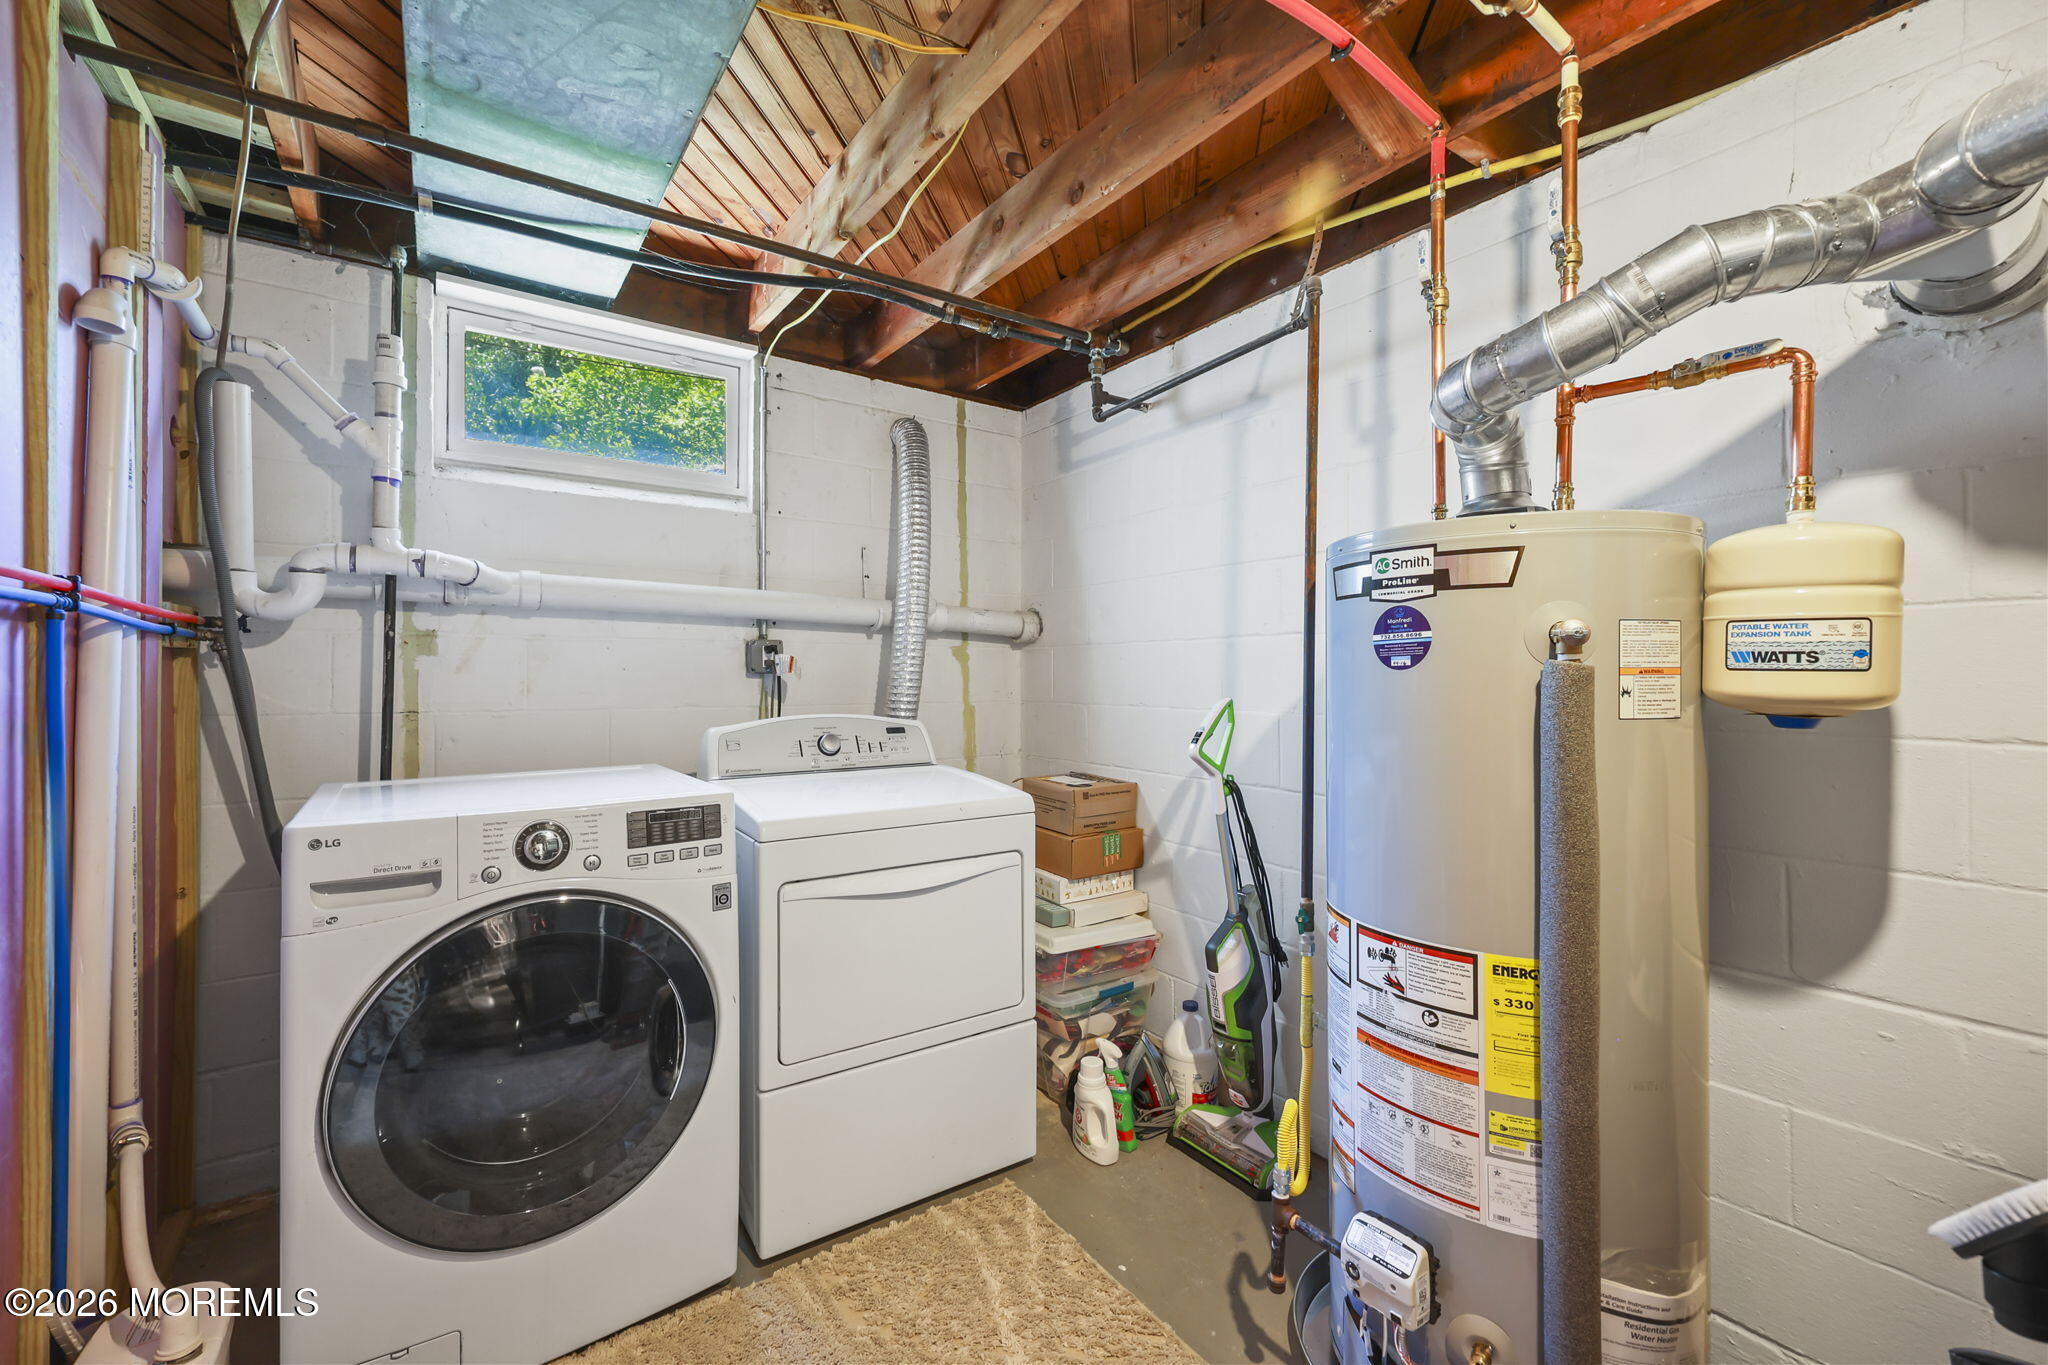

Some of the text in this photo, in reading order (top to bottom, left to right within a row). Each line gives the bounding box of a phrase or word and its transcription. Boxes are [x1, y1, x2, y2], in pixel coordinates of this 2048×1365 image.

[1773, 622, 1809, 630] WATER
[324, 838, 341, 848] LG
[373, 864, 412, 874] Direct Drive
[1398, 942, 1424, 954] DANGER
[1504, 998, 1534, 1011] 330
[1624, 1320, 1668, 1335] Residential
[1630, 1332, 1656, 1343] Water
